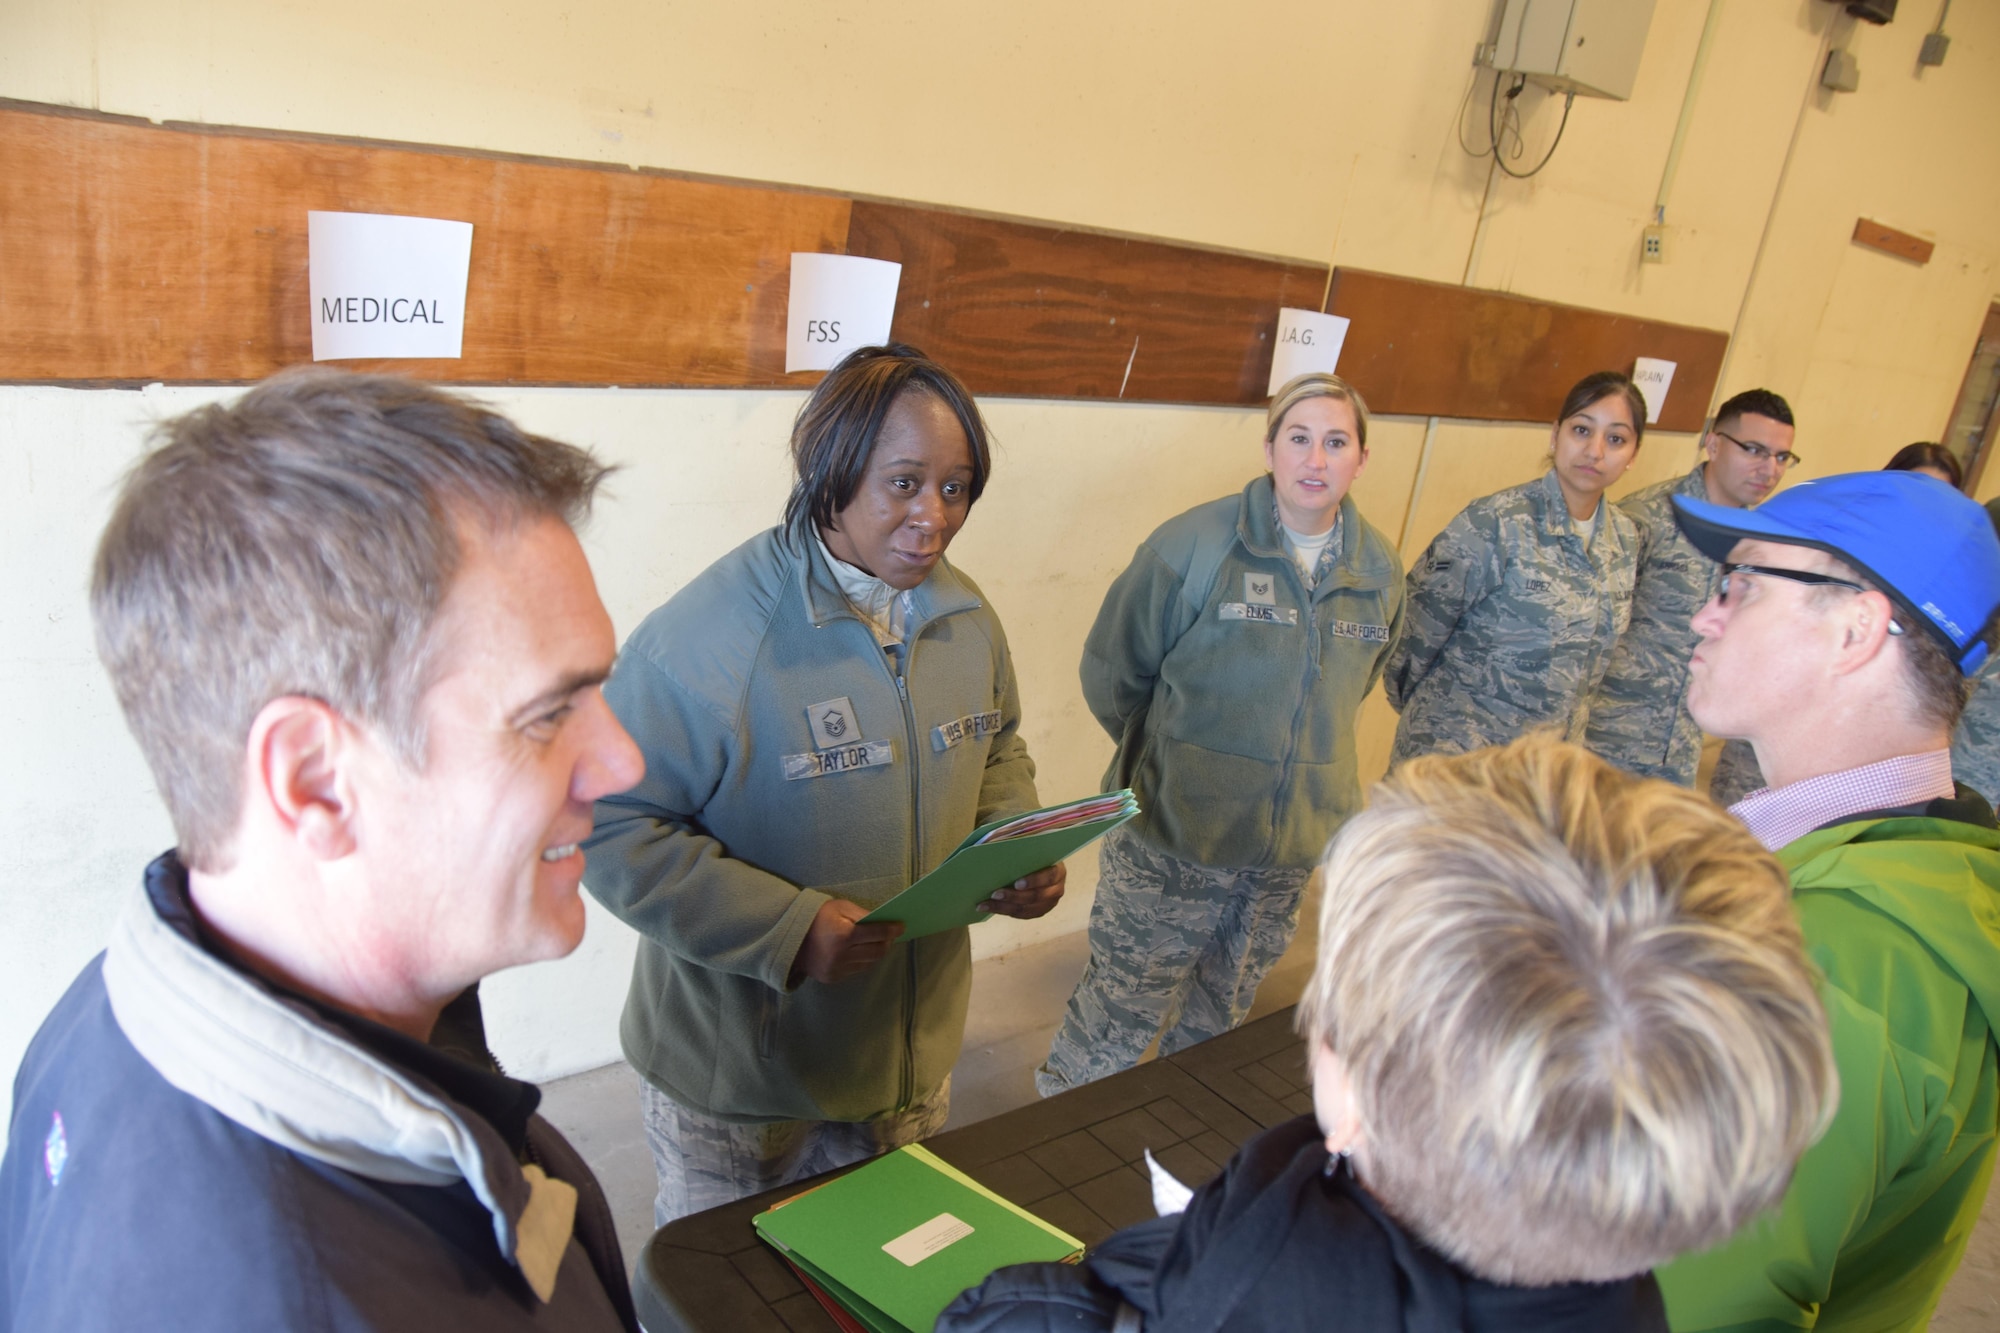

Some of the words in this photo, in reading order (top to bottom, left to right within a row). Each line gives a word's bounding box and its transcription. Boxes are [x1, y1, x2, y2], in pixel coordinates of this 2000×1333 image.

[322, 297, 444, 323] MEDICAL
[807, 320, 841, 343] FSS
[1281, 326, 1315, 346] J.A.G.
[1525, 580, 1551, 593] LOPEZ
[1246, 606, 1273, 620] ELMS
[1358, 625, 1388, 640] FORCE
[974, 713, 999, 734] FORCE
[816, 747, 870, 773] TAYLOR
